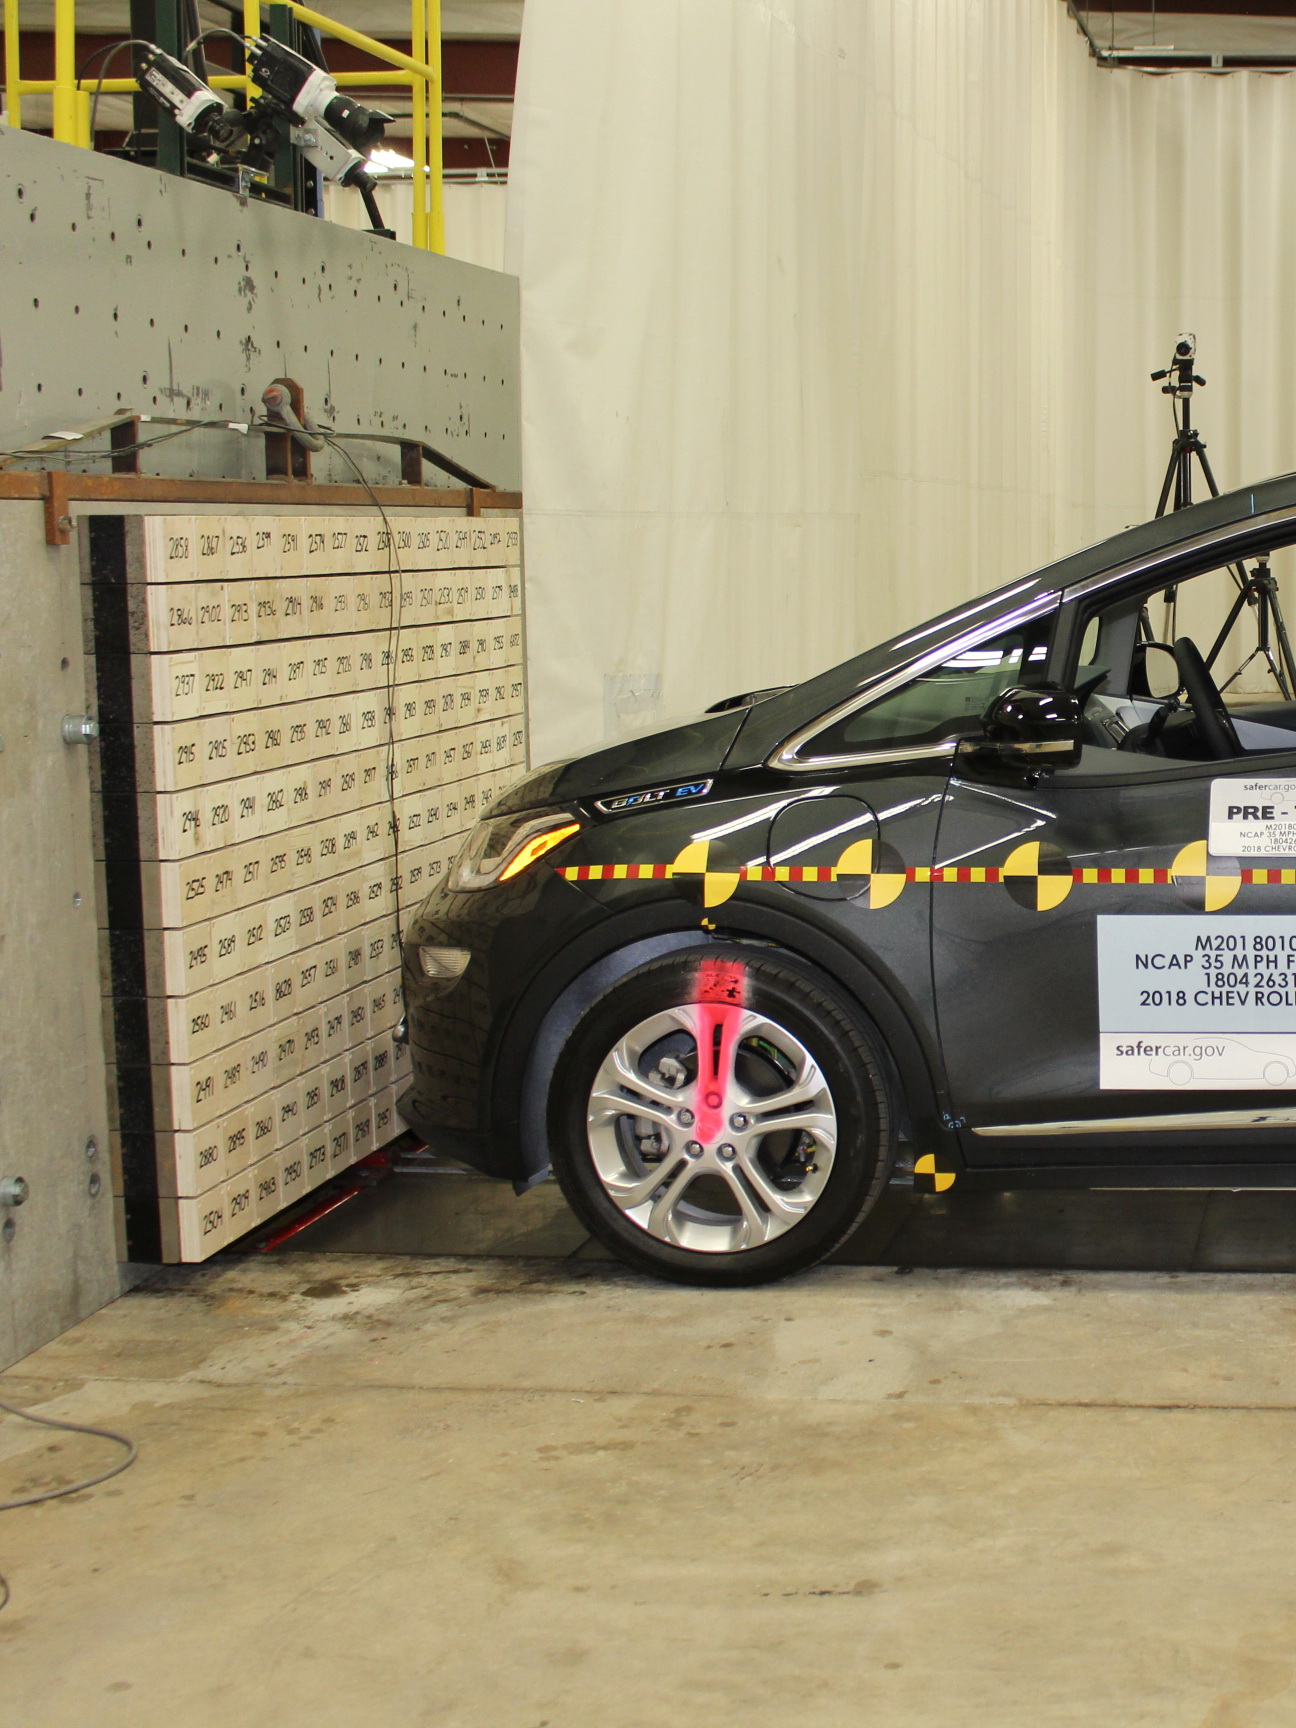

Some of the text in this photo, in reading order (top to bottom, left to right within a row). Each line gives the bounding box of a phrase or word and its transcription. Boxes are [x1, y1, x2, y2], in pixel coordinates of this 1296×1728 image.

[168, 536, 188, 559] 2858
[200, 534, 219, 556] 2867
[229, 535, 247, 555] 2536
[281, 533, 297, 553] 2591
[307, 533, 325, 553] 2574
[332, 532, 347, 549] 2527
[354, 534, 368, 552] 2572
[169, 607, 192, 626] 2866
[200, 603, 221, 624] 2902
[230, 602, 249, 622] 2913
[257, 600, 276, 618] 2936
[284, 595, 301, 616] 2904
[334, 594, 347, 612] 2931
[354, 592, 371, 611] 2961
[174, 673, 195, 696] 2937
[205, 672, 224, 692] 2922
[233, 668, 252, 689] 2947
[261, 667, 277, 686] 2914
[288, 660, 304, 681] 2897
[312, 656, 328, 676] 2925
[336, 655, 351, 675] 2926
[177, 742, 195, 765] 2915
[208, 738, 227, 760] 2905
[236, 732, 255, 755] 2953
[264, 728, 281, 749] 2960
[289, 723, 306, 743] 2935
[314, 717, 331, 737] 2942
[182, 809, 200, 834] 2946
[211, 803, 229, 826] 2920
[239, 796, 255, 819] 2941
[266, 788, 284, 812] 2862
[293, 786, 309, 804] 2906
[318, 777, 331, 797] 2919
[341, 771, 355, 791] 2509
[363, 766, 376, 784] 2917
[675, 783, 705, 797] EV
[1227, 805, 1275, 820] PRE
[185, 876, 206, 900] 2525
[214, 869, 233, 892] 2474
[243, 860, 259, 883] 2517
[270, 852, 286, 873] 2595
[295, 847, 312, 866] 2548
[320, 836, 336, 857] 2508
[343, 830, 357, 850] 2894
[188, 944, 208, 969] 2495
[218, 934, 235, 958] 2589
[246, 923, 263, 946] 2512
[274, 914, 291, 937] 2523
[321, 895, 337, 917] 2524
[345, 889, 360, 909] 2586
[368, 881, 382, 900] 2529
[1135, 954, 1194, 970] NCAP
[1201, 954, 1224, 970] 35
[1231, 954, 1278, 970] MPH
[191, 1013, 209, 1034] 2560
[219, 1000, 236, 1024] 2461
[248, 990, 265, 1011] 2516
[274, 977, 292, 1001] 8628
[300, 964, 317, 988] 2557
[324, 958, 338, 977] 2561
[369, 938, 383, 959] 2553
[1139, 990, 1187, 1007] 2018
[195, 1075, 213, 1103] 2491
[223, 1063, 241, 1088] 2489
[250, 1050, 268, 1074] 2490
[278, 1038, 295, 1061] 2470
[304, 1026, 319, 1050] 2493
[327, 1014, 342, 1037] 2479
[1115, 1041, 1226, 1060] safercar.gov
[199, 1144, 218, 1169] 2880
[227, 1127, 245, 1153] 2895
[254, 1116, 272, 1140] 2860
[281, 1100, 297, 1122] 2940
[306, 1086, 320, 1109] 2851
[329, 1074, 345, 1097] 2908
[203, 1210, 222, 1236] 2504
[230, 1189, 249, 1217] 2909
[258, 1176, 276, 1201] 2963
[283, 1160, 301, 1185] 2950
[308, 1144, 325, 1169] 2973
[332, 1131, 348, 1158] 2971
